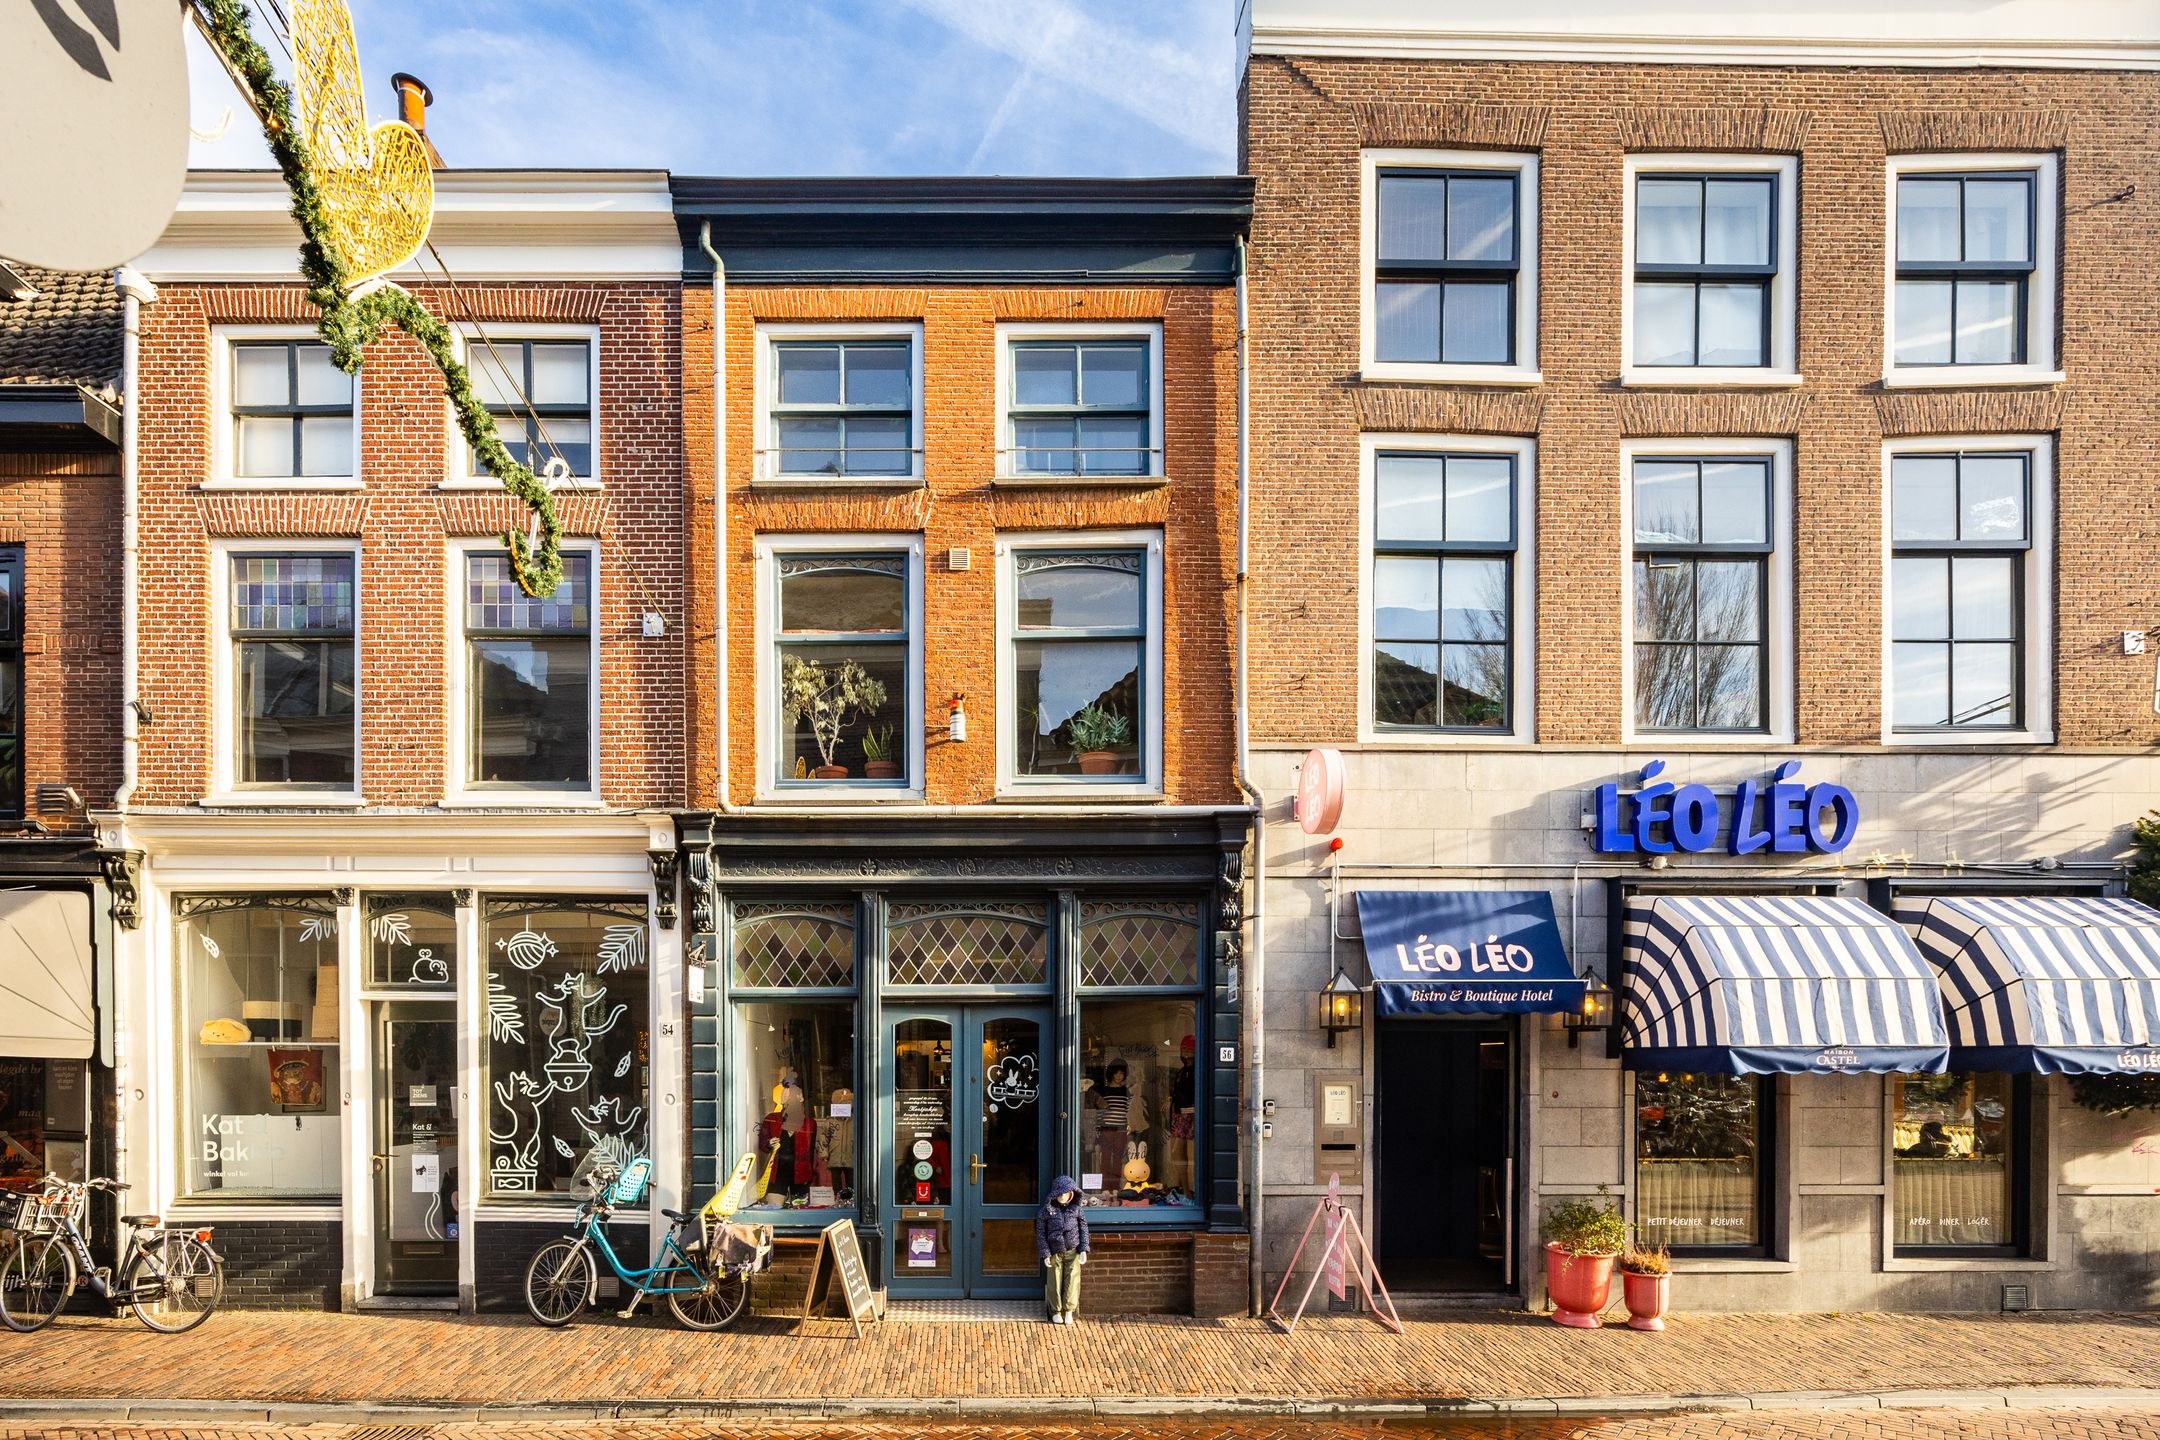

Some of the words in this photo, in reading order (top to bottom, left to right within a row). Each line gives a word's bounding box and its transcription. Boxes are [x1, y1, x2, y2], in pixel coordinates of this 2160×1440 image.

[1596, 759, 1719, 854] LÉO
[1728, 759, 1859, 857] LÉO
[1396, 934, 1462, 972] LÉO
[1470, 934, 1534, 973] LÉO
[1411, 989, 1447, 1002] Bistro
[1449, 989, 1463, 1002] &
[1465, 989, 1518, 1004] Boutique
[1521, 989, 1553, 1001] Hotel
[662, 1024, 674, 1036] 54
[1222, 1050, 1232, 1060] 56
[1816, 1055, 1861, 1065] CASTEL
[2116, 1051, 2141, 1068] LÉO
[202, 1114, 244, 1135] Kat
[412, 1123, 425, 1131] Kat
[1648, 1217, 1668, 1226] PETIT
[1669, 1216, 1703, 1227] DÉJEUNER
[1710, 1216, 1745, 1227] DÉJEUNER
[1909, 1216, 1931, 1226] APÉRO
